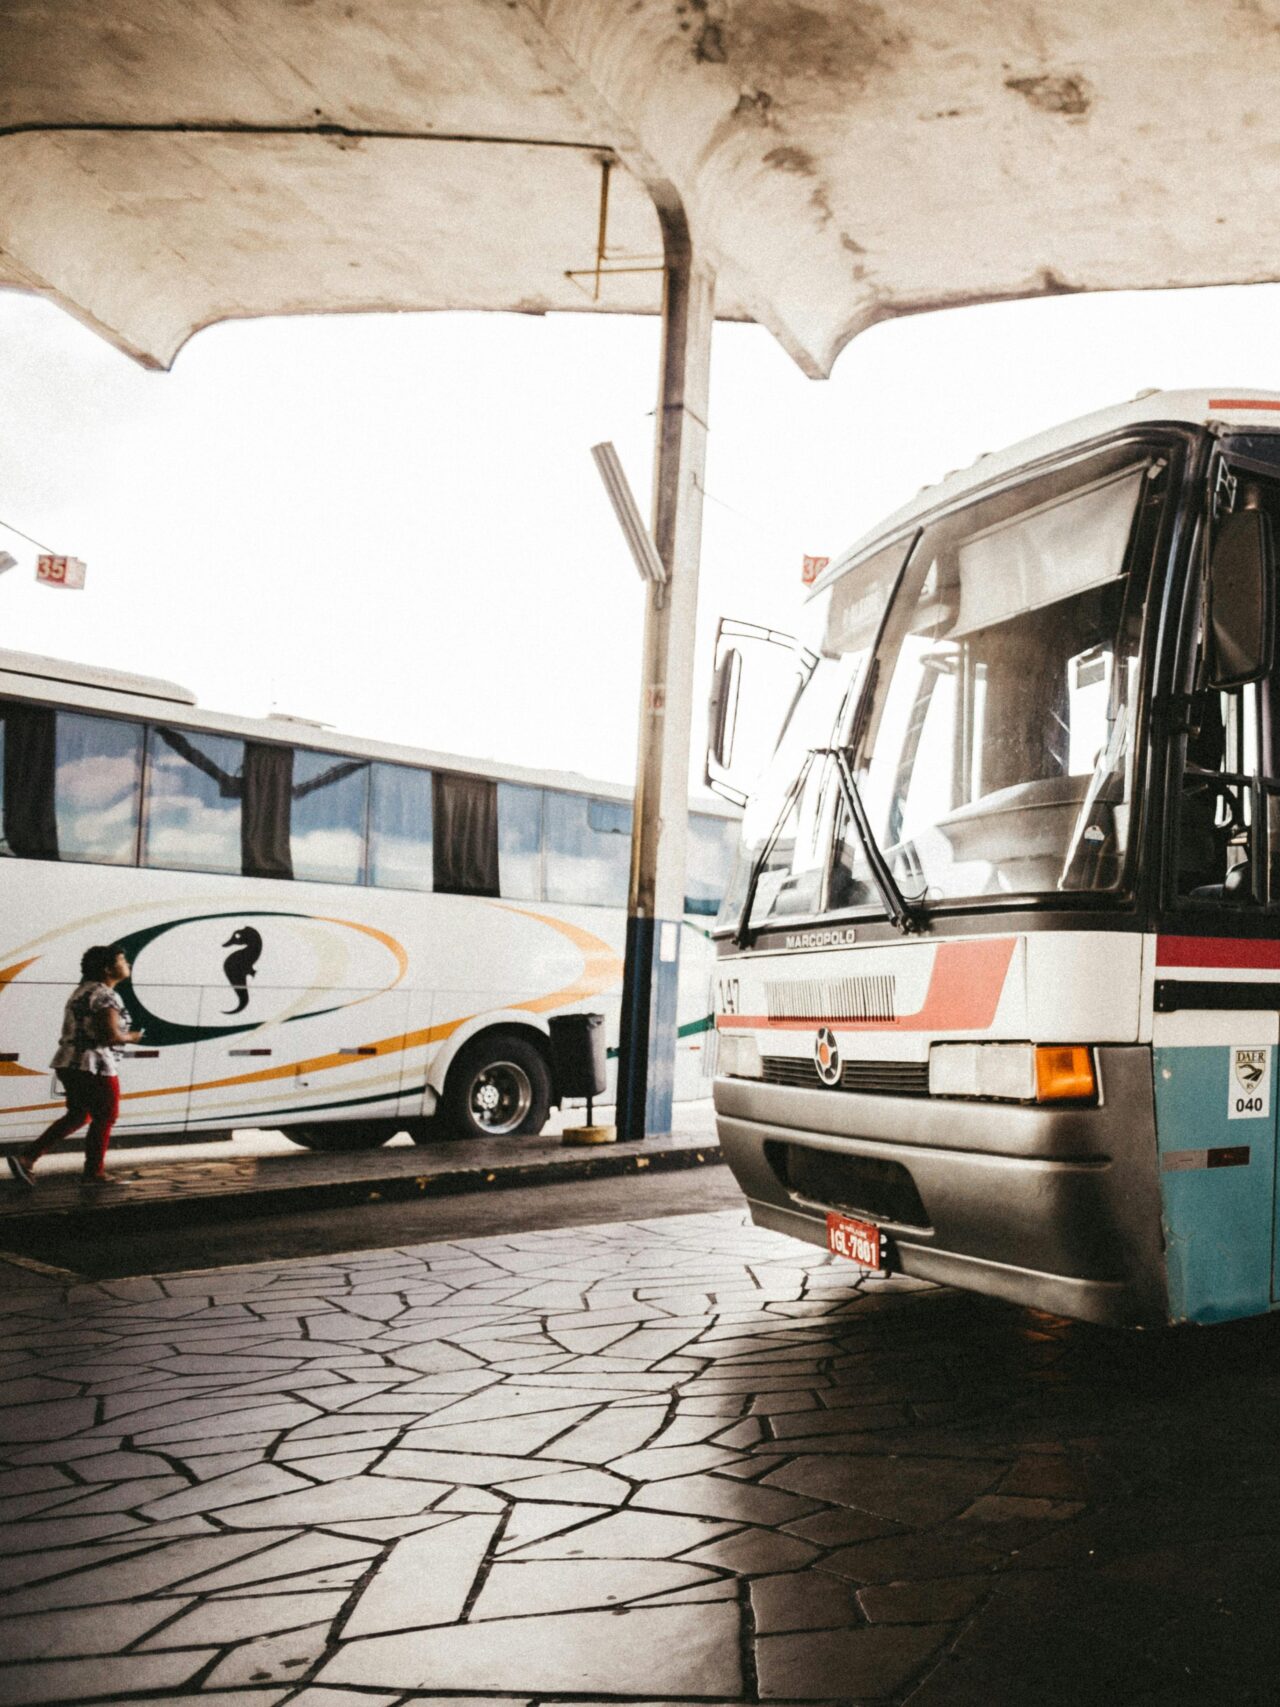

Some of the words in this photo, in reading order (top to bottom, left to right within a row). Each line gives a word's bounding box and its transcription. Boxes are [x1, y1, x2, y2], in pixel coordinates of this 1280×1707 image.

[39, 559, 65, 579] 35
[786, 929, 855, 949] MARCOPOLO
[719, 979, 740, 1014] 147
[1236, 1098, 1263, 1112] 040
